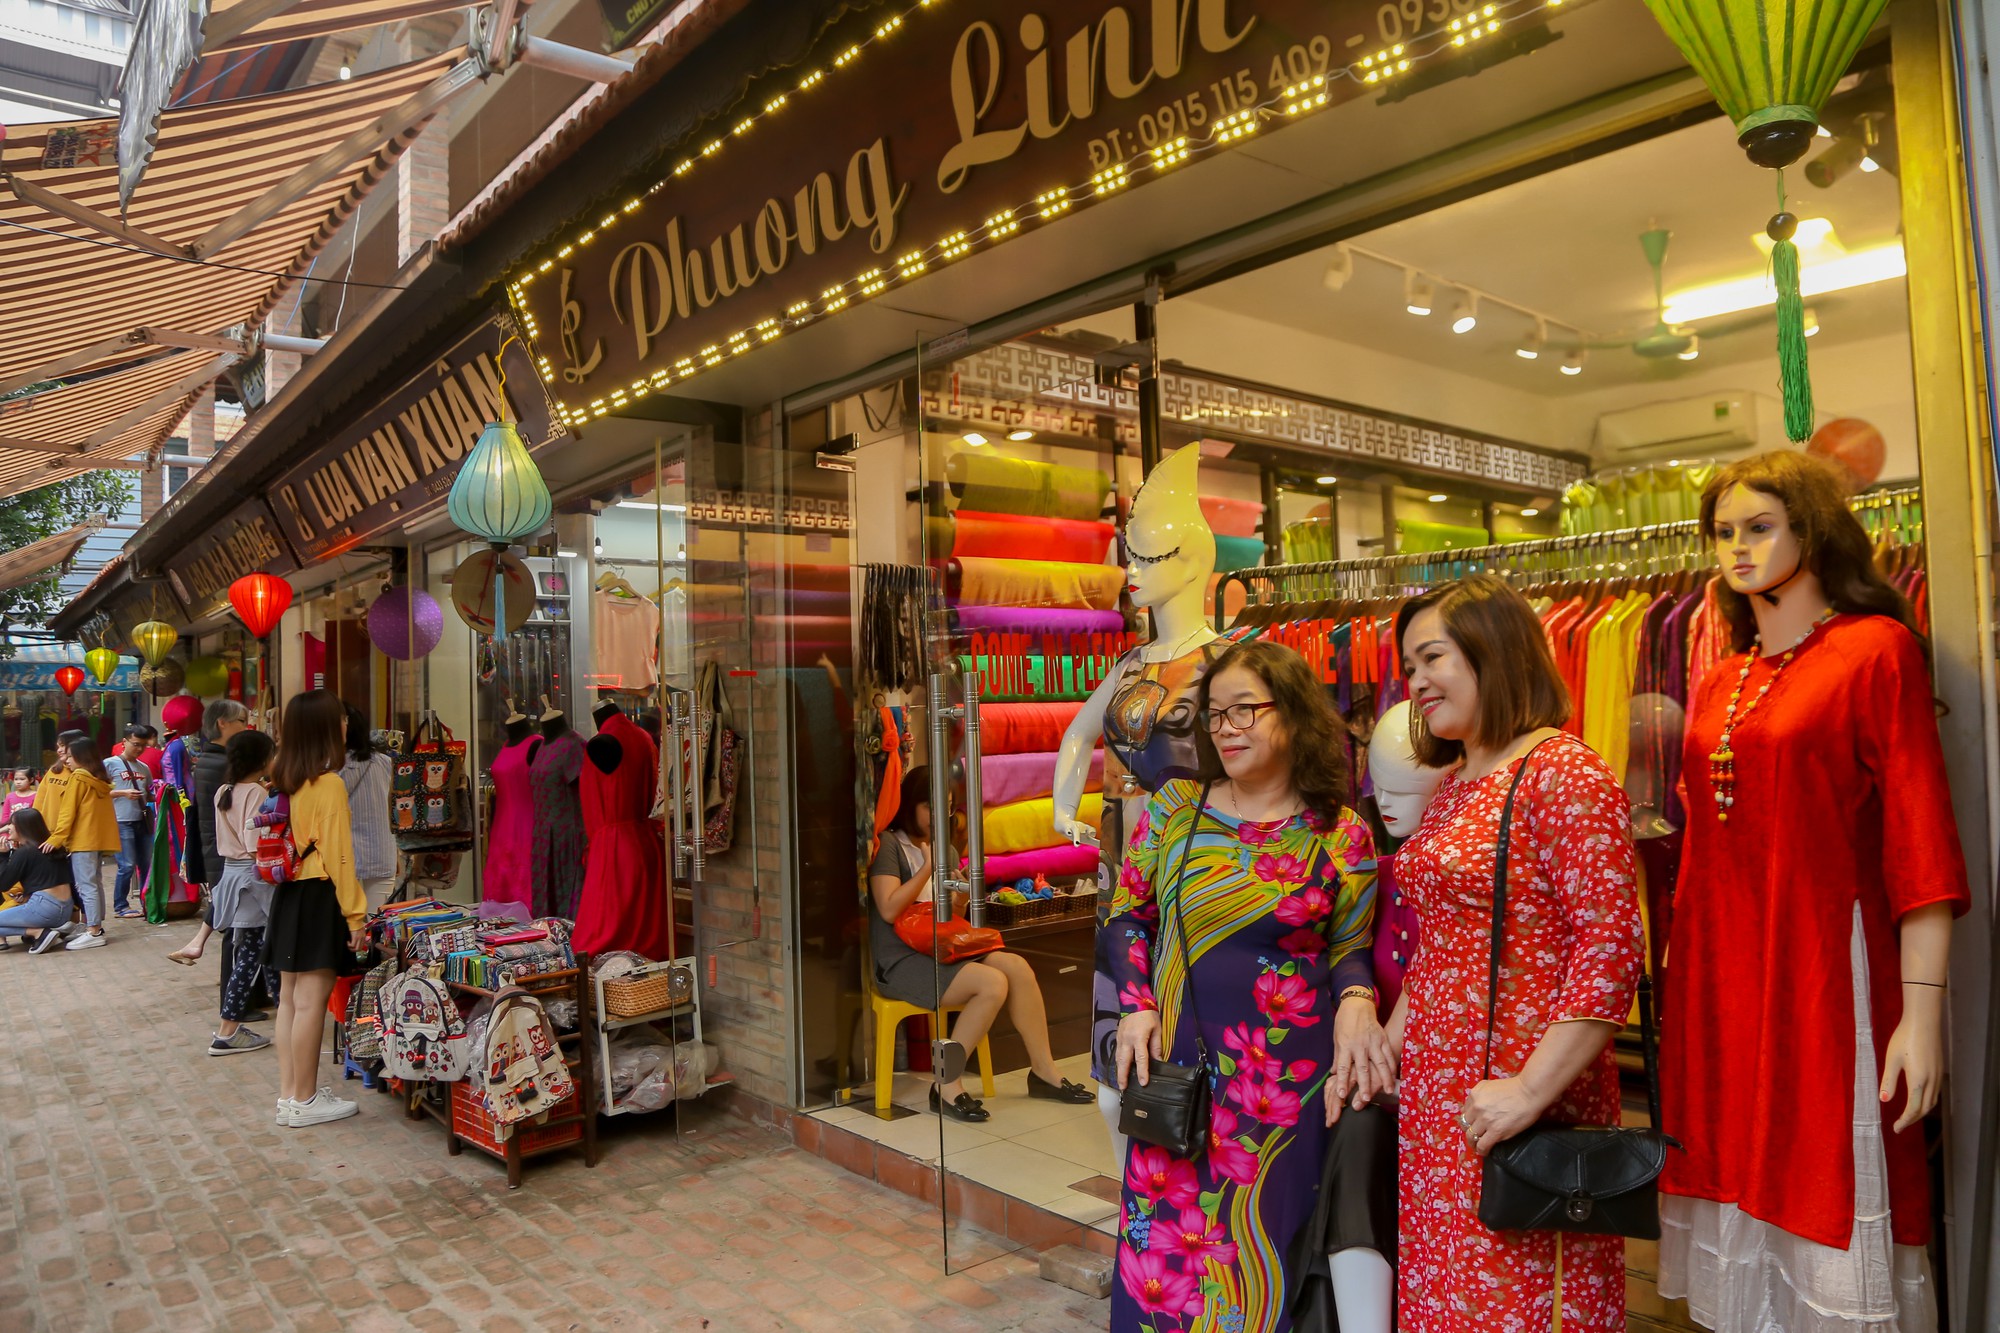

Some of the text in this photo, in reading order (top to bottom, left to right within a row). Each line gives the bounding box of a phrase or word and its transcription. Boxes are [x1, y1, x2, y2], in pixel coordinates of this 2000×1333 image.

[1210, 68, 1258, 116] 115
[1268, 35, 1331, 90] 409
[304, 459, 363, 537] LỤA
[343, 422, 419, 512] VẠN
[399, 352, 518, 476] XUÂN
[971, 631, 1034, 696] COME
[1042, 633, 1064, 694] IN
[1350, 615, 1378, 683] IN
